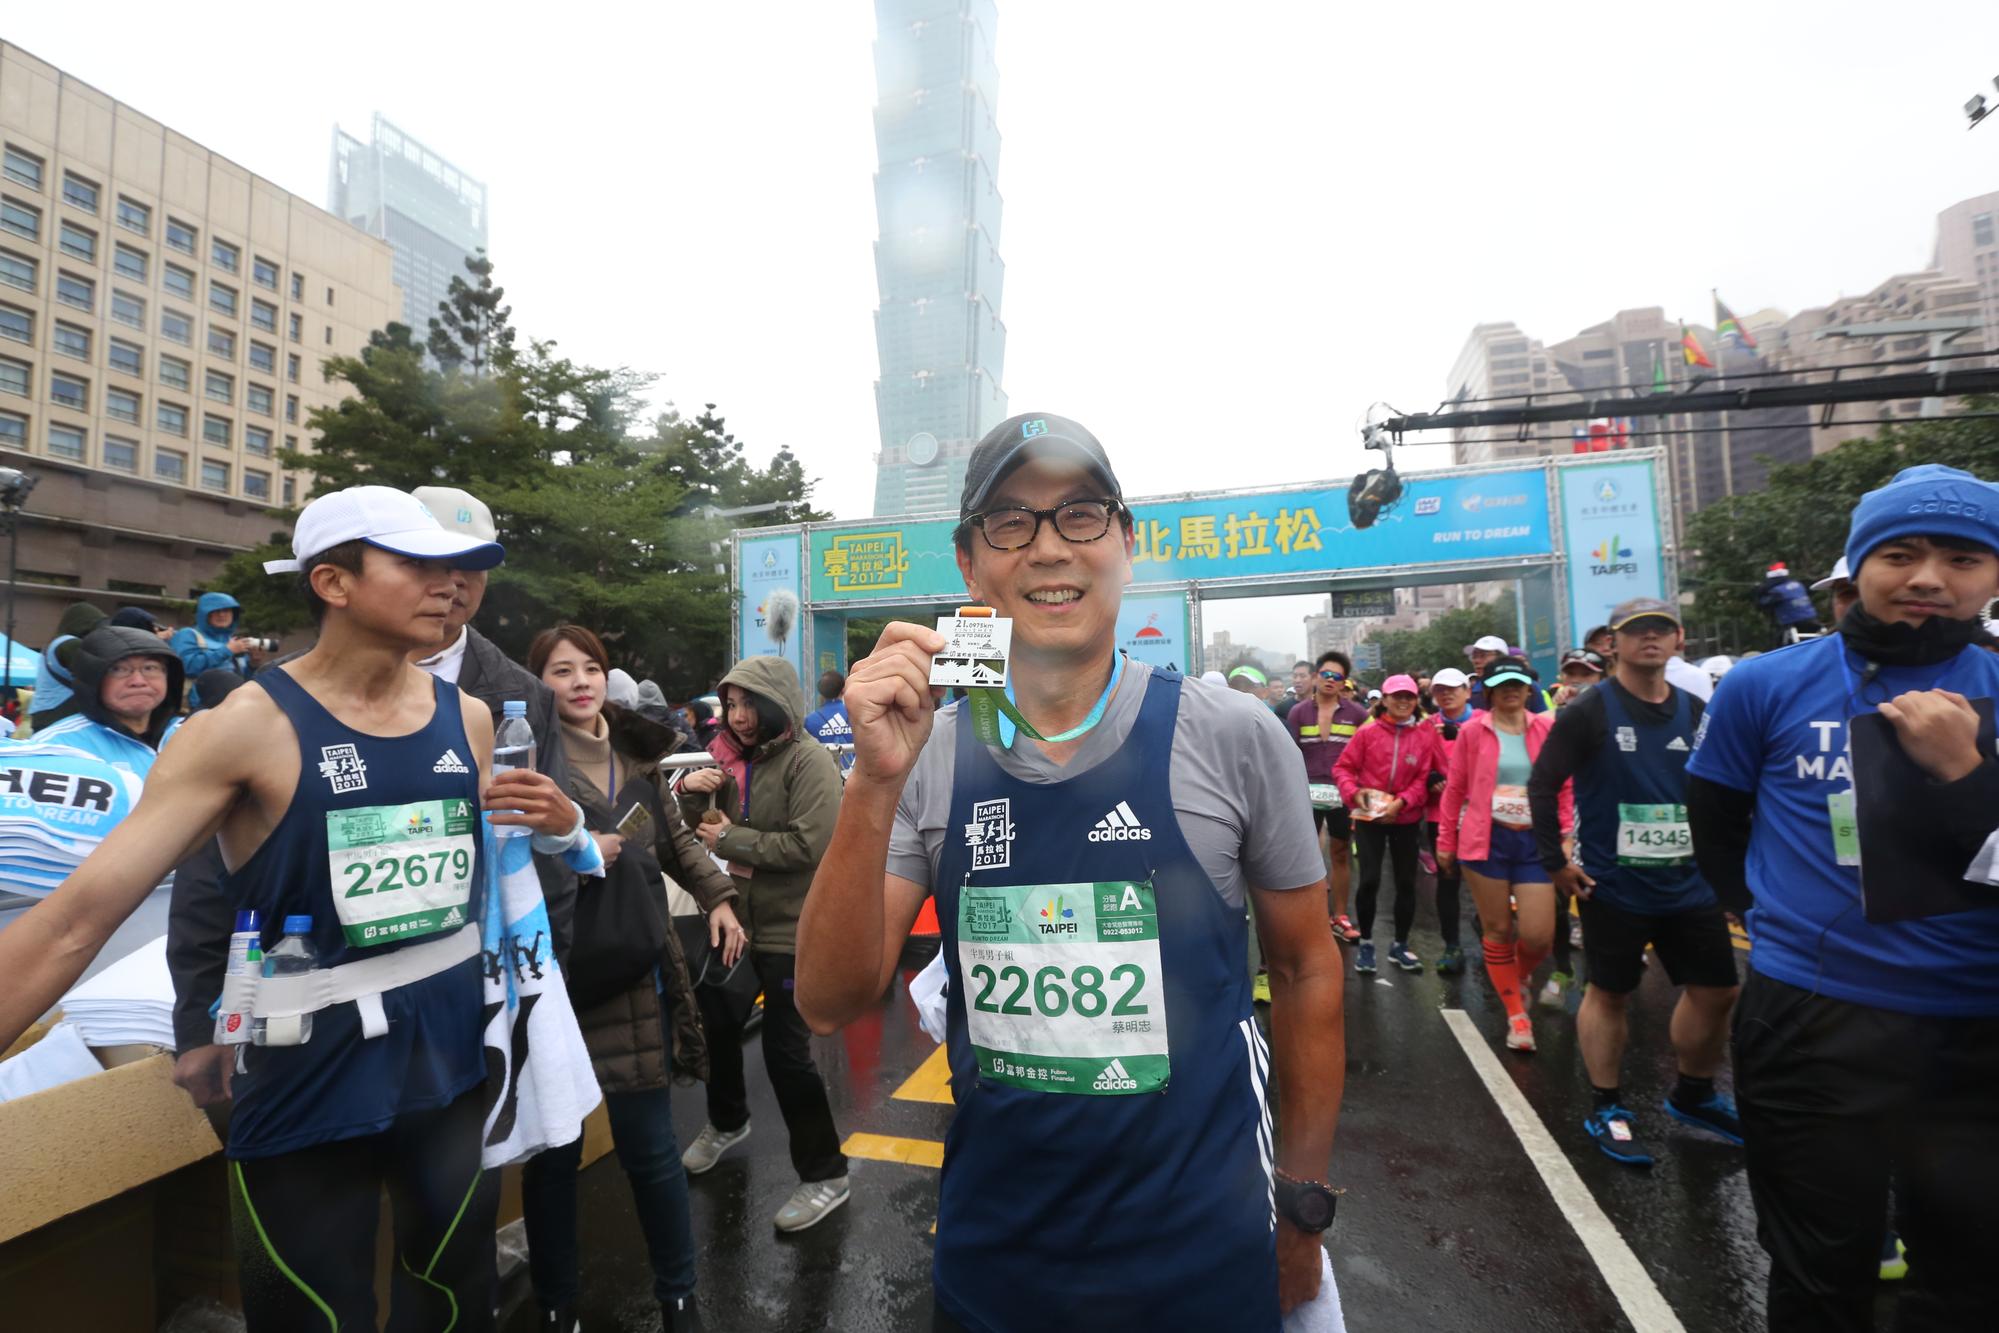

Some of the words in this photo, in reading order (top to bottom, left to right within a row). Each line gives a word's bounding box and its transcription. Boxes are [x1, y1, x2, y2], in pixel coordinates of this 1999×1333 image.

[1132, 508, 1323, 564] 北馬拉松
[1433, 530, 1461, 543] RUN
[1465, 529, 1482, 541] TO
[1484, 525, 1531, 539] DREAM
[850, 542, 885, 553] TAIPEI
[1590, 563, 1638, 576] TAIPEI
[850, 571, 884, 585] 2017
[327, 747, 353, 757] TAIPEI
[433, 764, 469, 774] adidas
[336, 780, 362, 791] 2017
[457, 801, 468, 817] A
[978, 805, 1005, 817] TAIPEI
[407, 826, 433, 835] TAIPEI
[1088, 826, 1151, 842] adidas
[1625, 829, 1690, 846] 14345
[976, 853, 1005, 865] 2017
[344, 848, 469, 899] 22679
[1119, 885, 1143, 911] A
[977, 922, 997, 930] 2017
[1038, 922, 1078, 935] TAIPEI
[971, 963, 1149, 1018] 22682
[1112, 1020, 1151, 1034] 蔡明忠
[1006, 1064, 1048, 1081] 富邦金控
[1093, 1078, 1138, 1090] adidas
